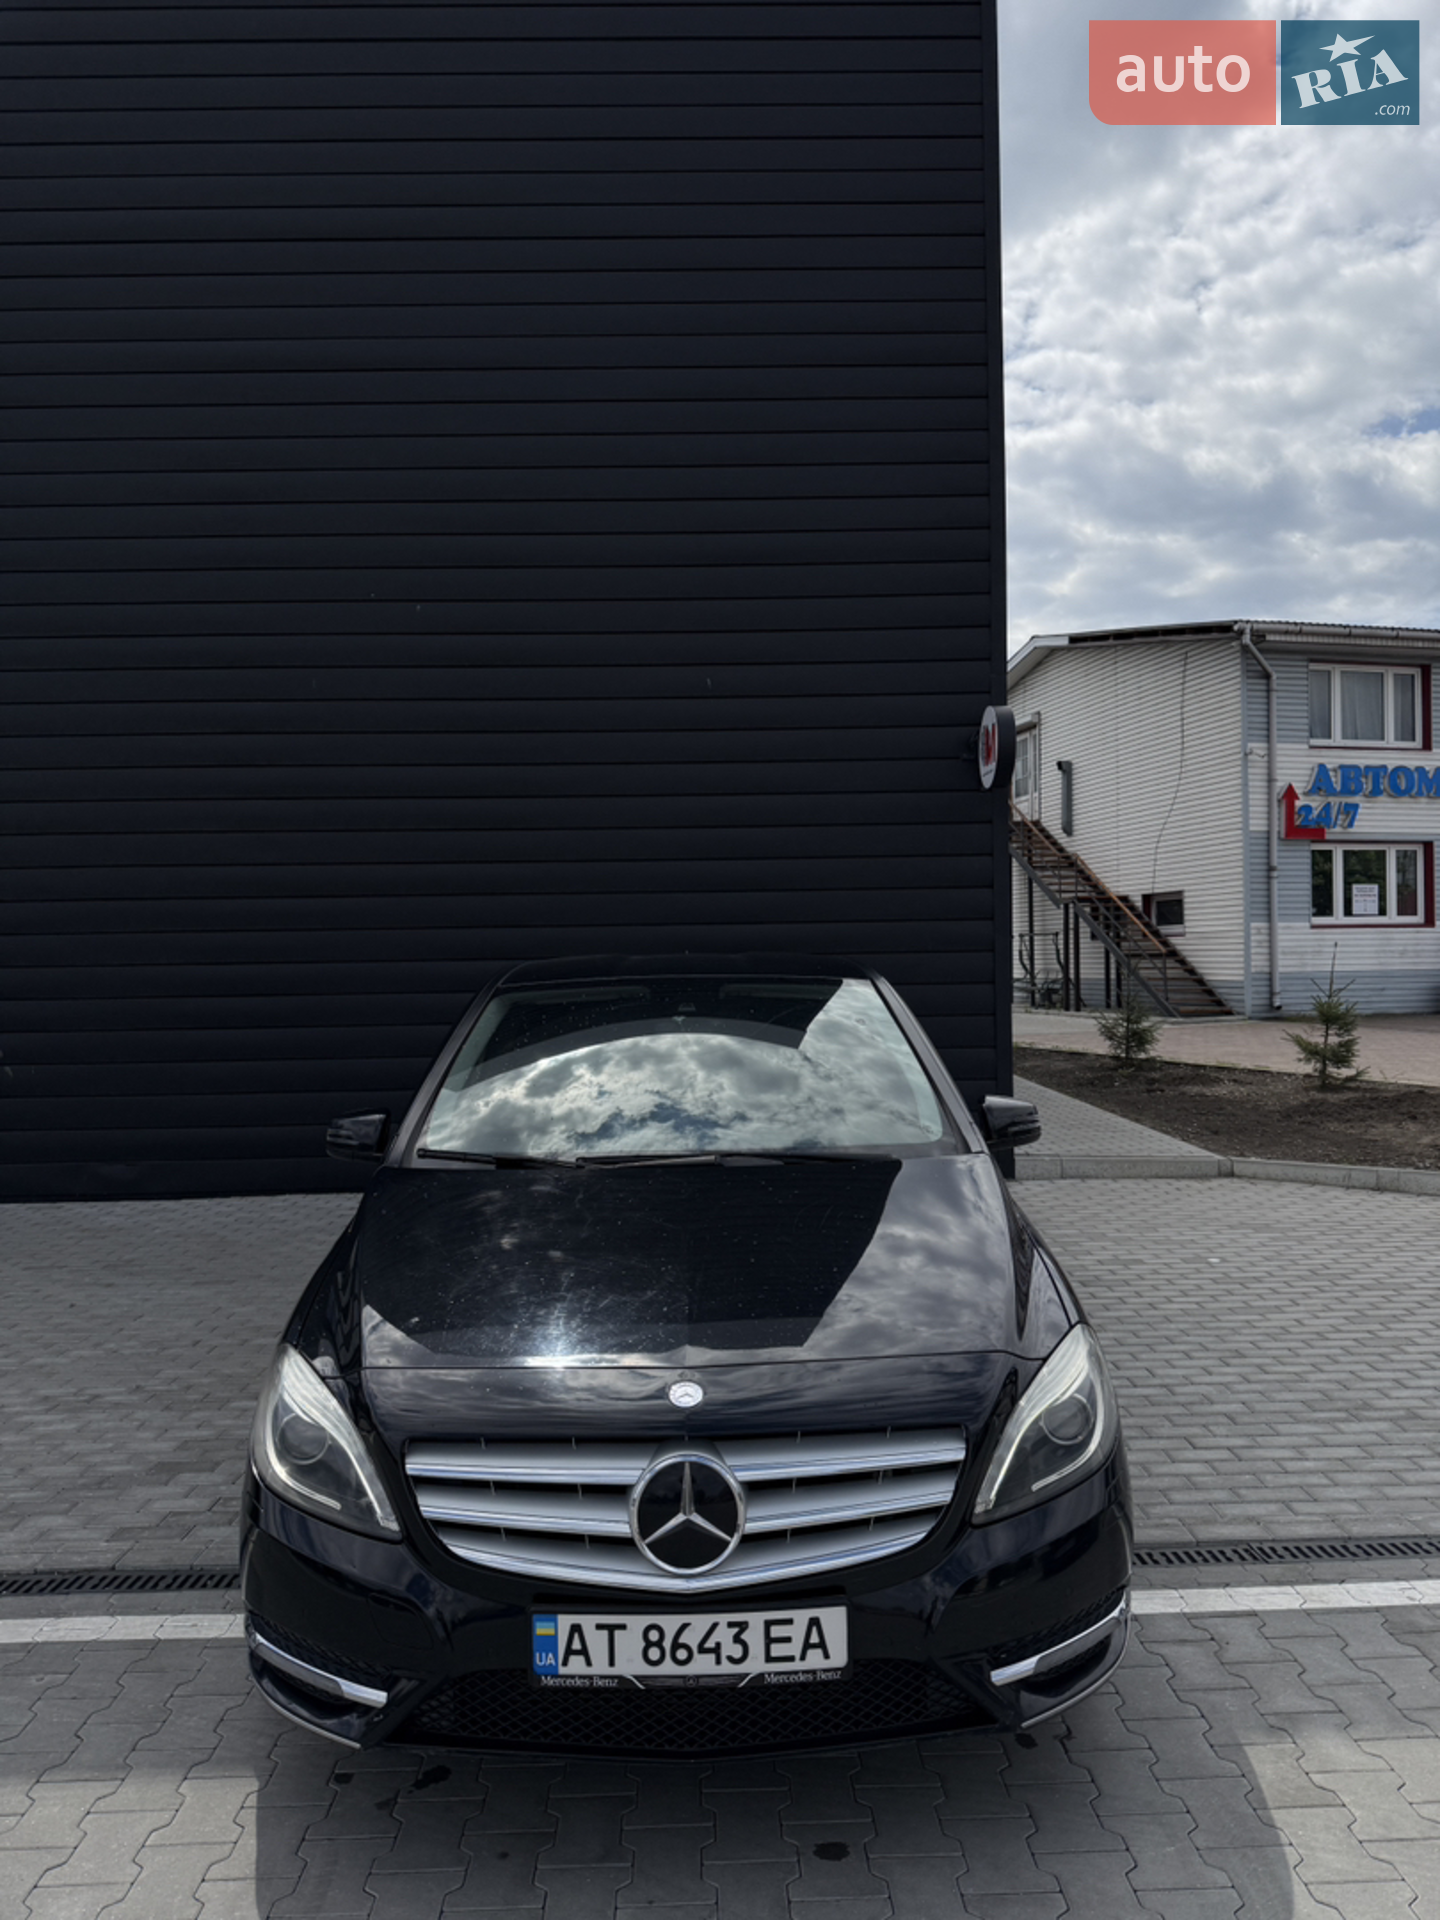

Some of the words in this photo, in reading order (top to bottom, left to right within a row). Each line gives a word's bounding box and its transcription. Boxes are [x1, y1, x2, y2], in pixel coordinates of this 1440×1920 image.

[1296, 802, 1359, 828] 24/7
[561, 1623, 627, 1668] AT
[641, 1621, 750, 1667] 8643
[763, 1616, 831, 1663] EA
[536, 1652, 556, 1666] UA
